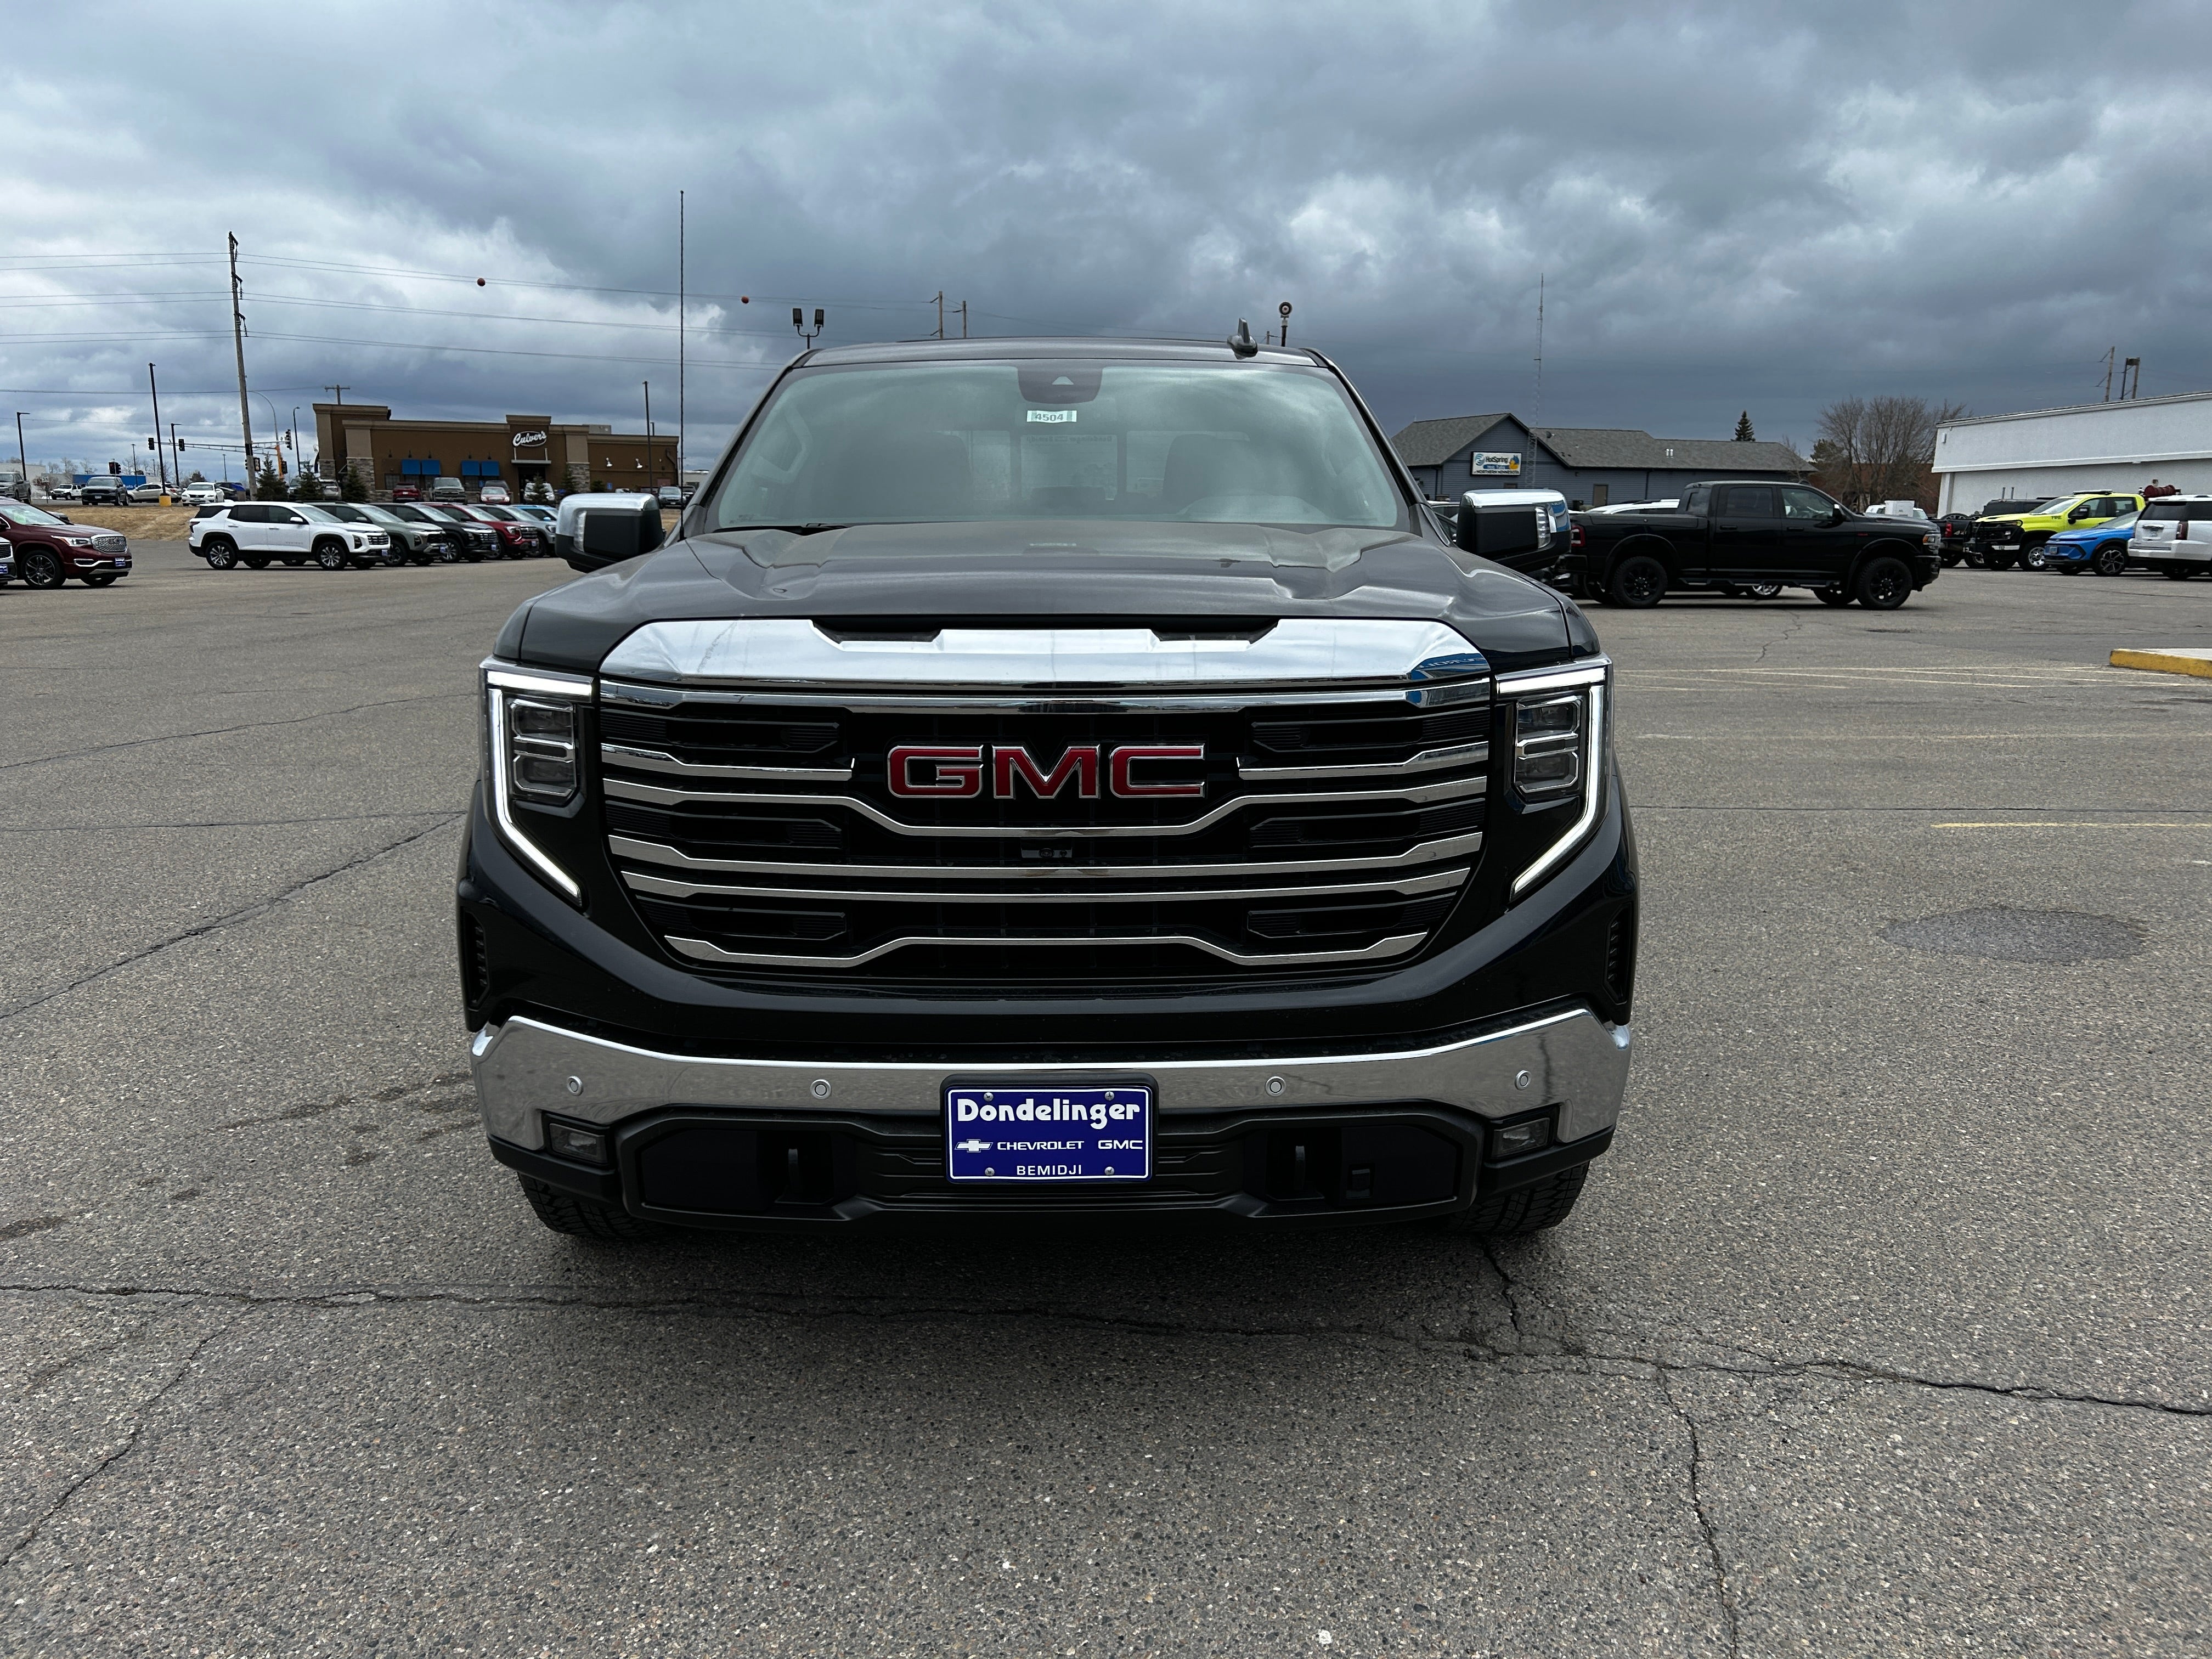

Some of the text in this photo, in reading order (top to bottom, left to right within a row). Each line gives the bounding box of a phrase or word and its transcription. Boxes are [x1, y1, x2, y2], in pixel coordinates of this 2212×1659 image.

[1035, 413, 1063, 421] 4504
[512, 431, 547, 447] Culver's
[887, 744, 1205, 799] GMC
[957, 1098, 1140, 1130] Dondelinger
[997, 1139, 1143, 1150] CHEVROLET GMC
[1017, 1165, 1082, 1176] BEMIDJI
